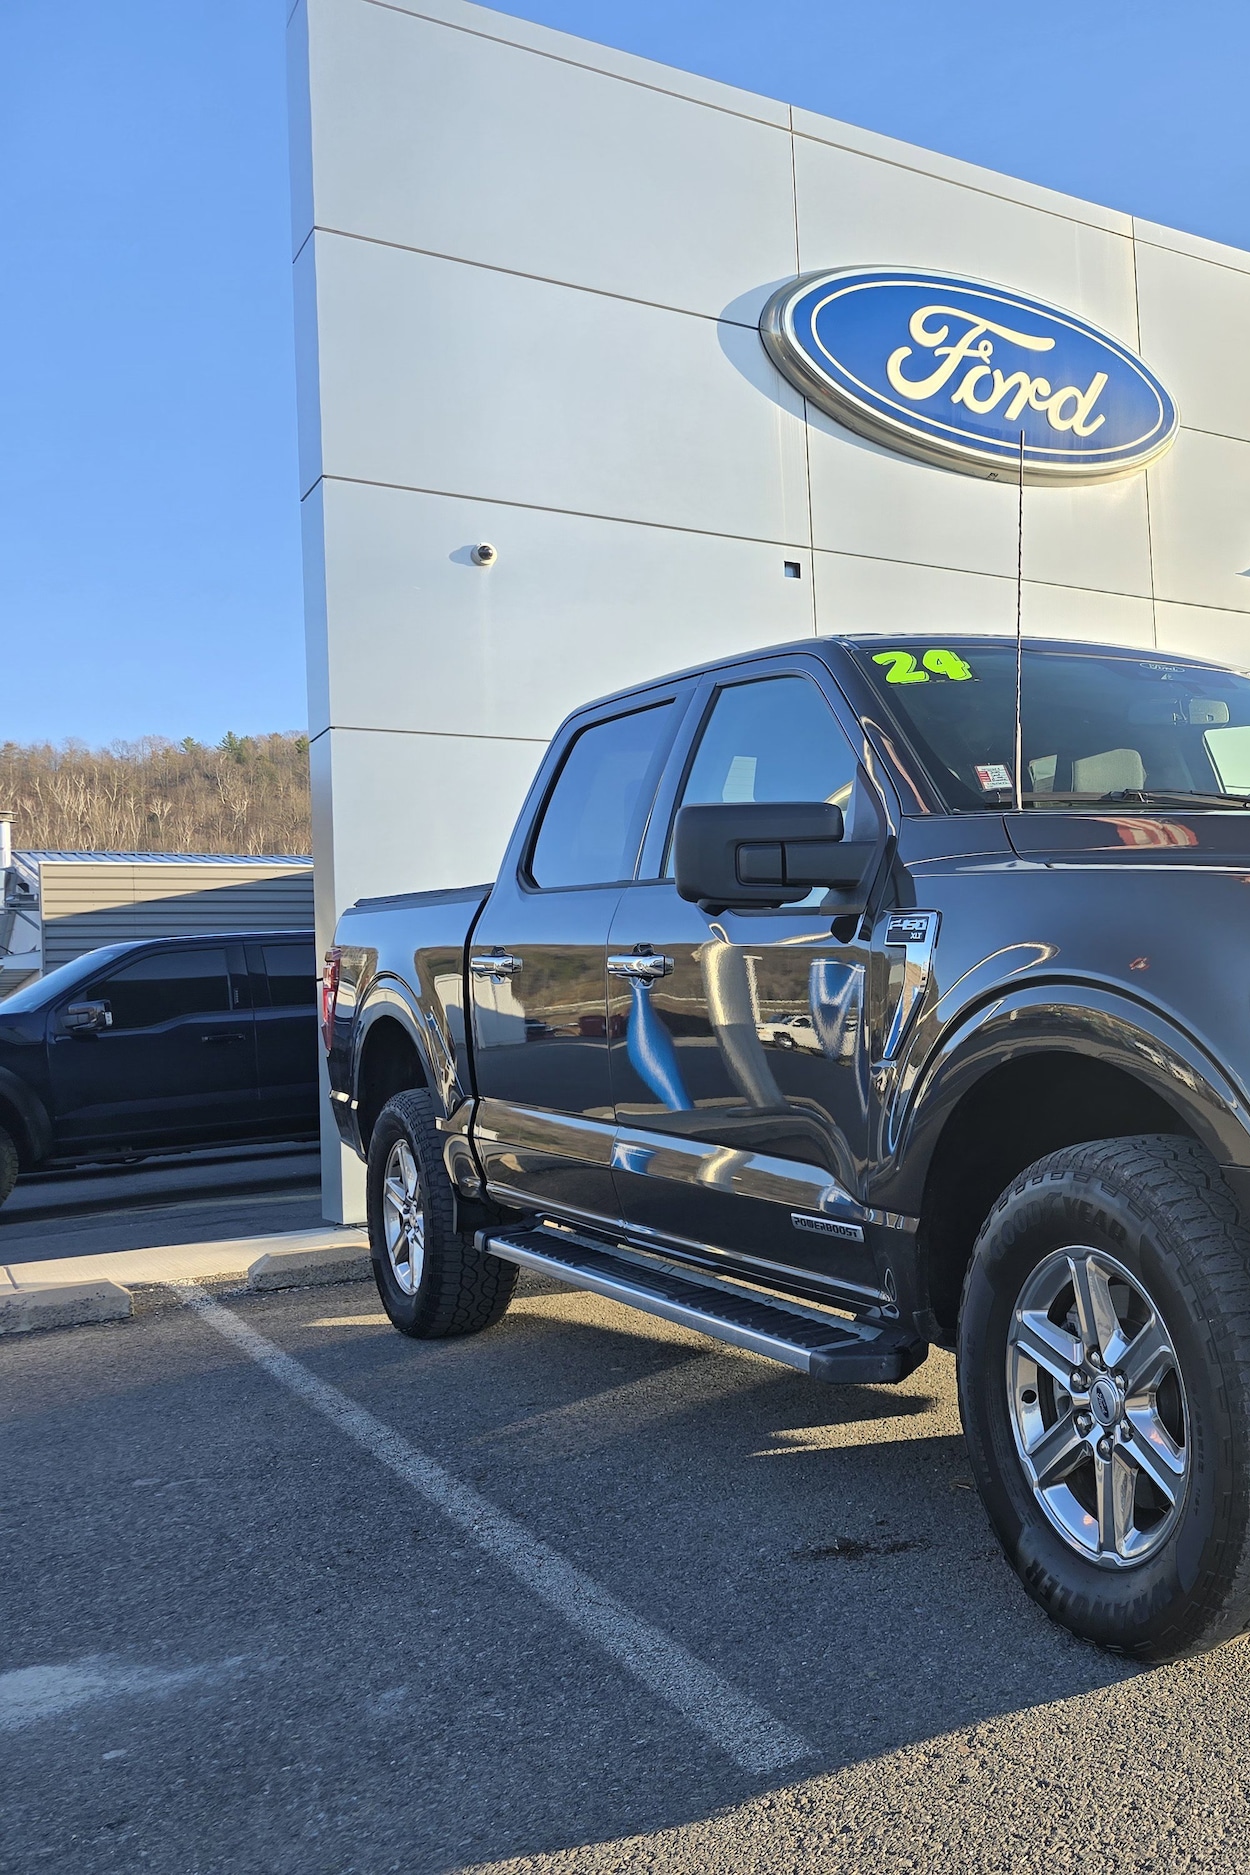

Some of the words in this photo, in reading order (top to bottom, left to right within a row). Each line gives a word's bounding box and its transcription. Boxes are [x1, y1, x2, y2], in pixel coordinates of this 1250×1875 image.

[886, 305, 1108, 437] Ford
[872, 649, 973, 684] 24
[888, 918, 927, 931] F-150
[792, 1216, 858, 1238] POWERBOOST
[989, 1193, 1128, 1260] GOODYEAR
